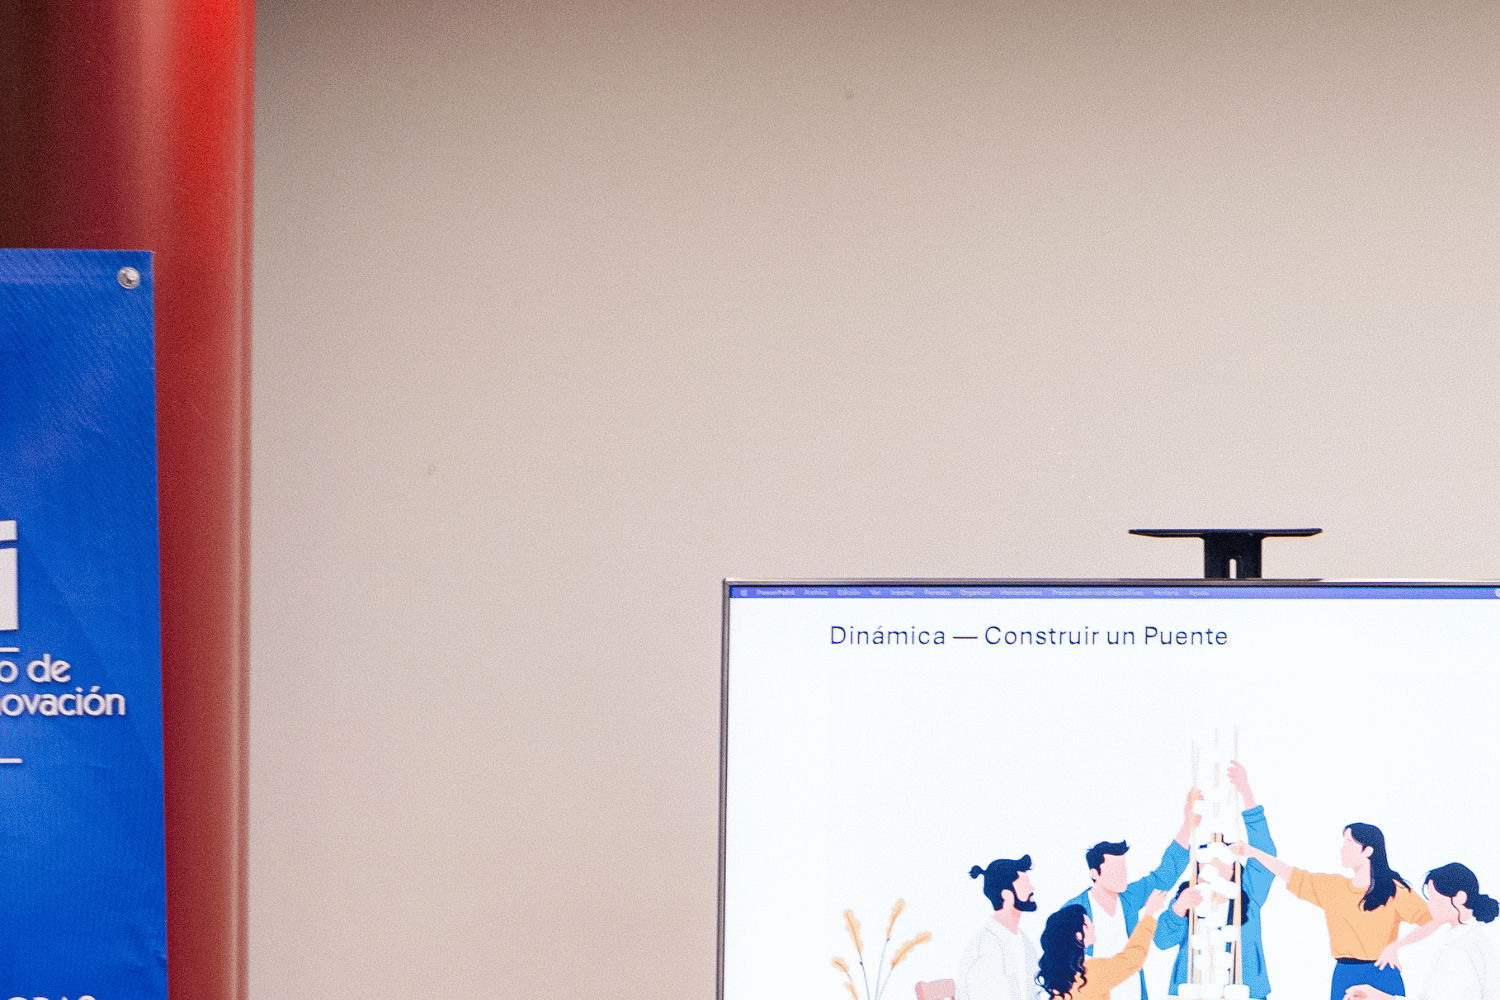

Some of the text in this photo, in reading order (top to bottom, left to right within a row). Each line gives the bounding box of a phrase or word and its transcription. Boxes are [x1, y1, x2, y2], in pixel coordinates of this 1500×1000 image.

[830, 625, 945, 645] Dinámica
[984, 625, 1100, 646] Construir
[1106, 630, 1135, 645] un
[1144, 625, 1228, 646] Puente
[26, 653, 71, 683] de
[0, 685, 126, 716] ovación
